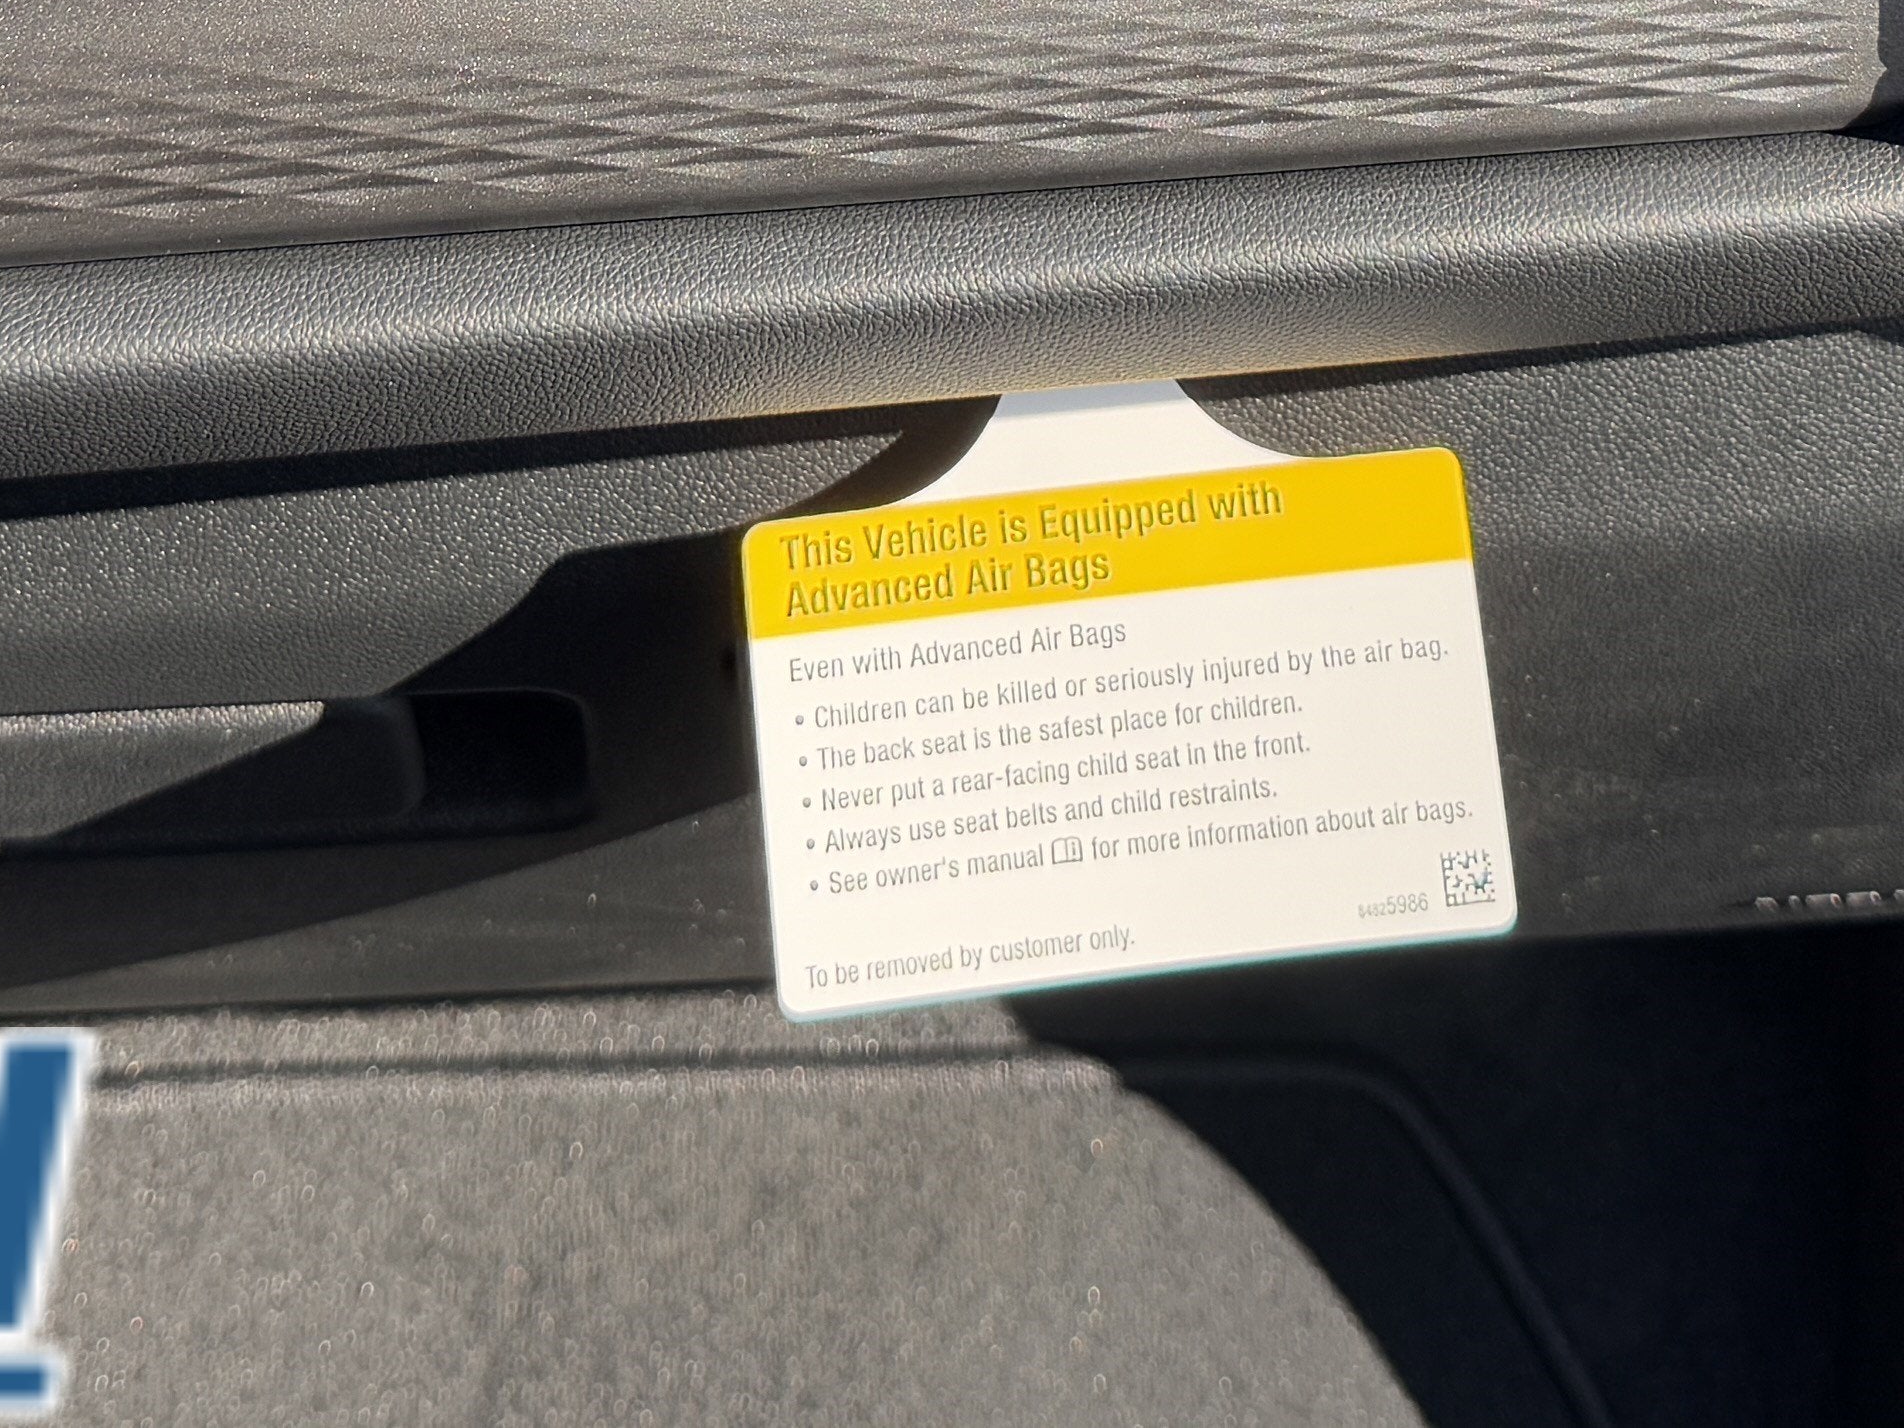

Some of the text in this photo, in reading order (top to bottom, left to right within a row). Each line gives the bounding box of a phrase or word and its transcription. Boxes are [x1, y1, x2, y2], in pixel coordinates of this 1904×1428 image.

[780, 482, 1282, 571] This Vehicle is Equipped with
[785, 551, 1111, 618] Advanced Air Bags
[789, 623, 1127, 683] Even with Advanced Air Bags
[814, 636, 1450, 729] Children can be killed or seriously injured by the air bag.
[815, 693, 1303, 771] The back seat is the safest place for children.
[821, 730, 1311, 812] Never put a rear-facing child seat in the front.
[824, 776, 1278, 855] Always use seat belts and child restraints.
[828, 799, 1474, 896] See owner's manual for more information about air bags.
[804, 923, 1136, 990] To be removed by customer only.
